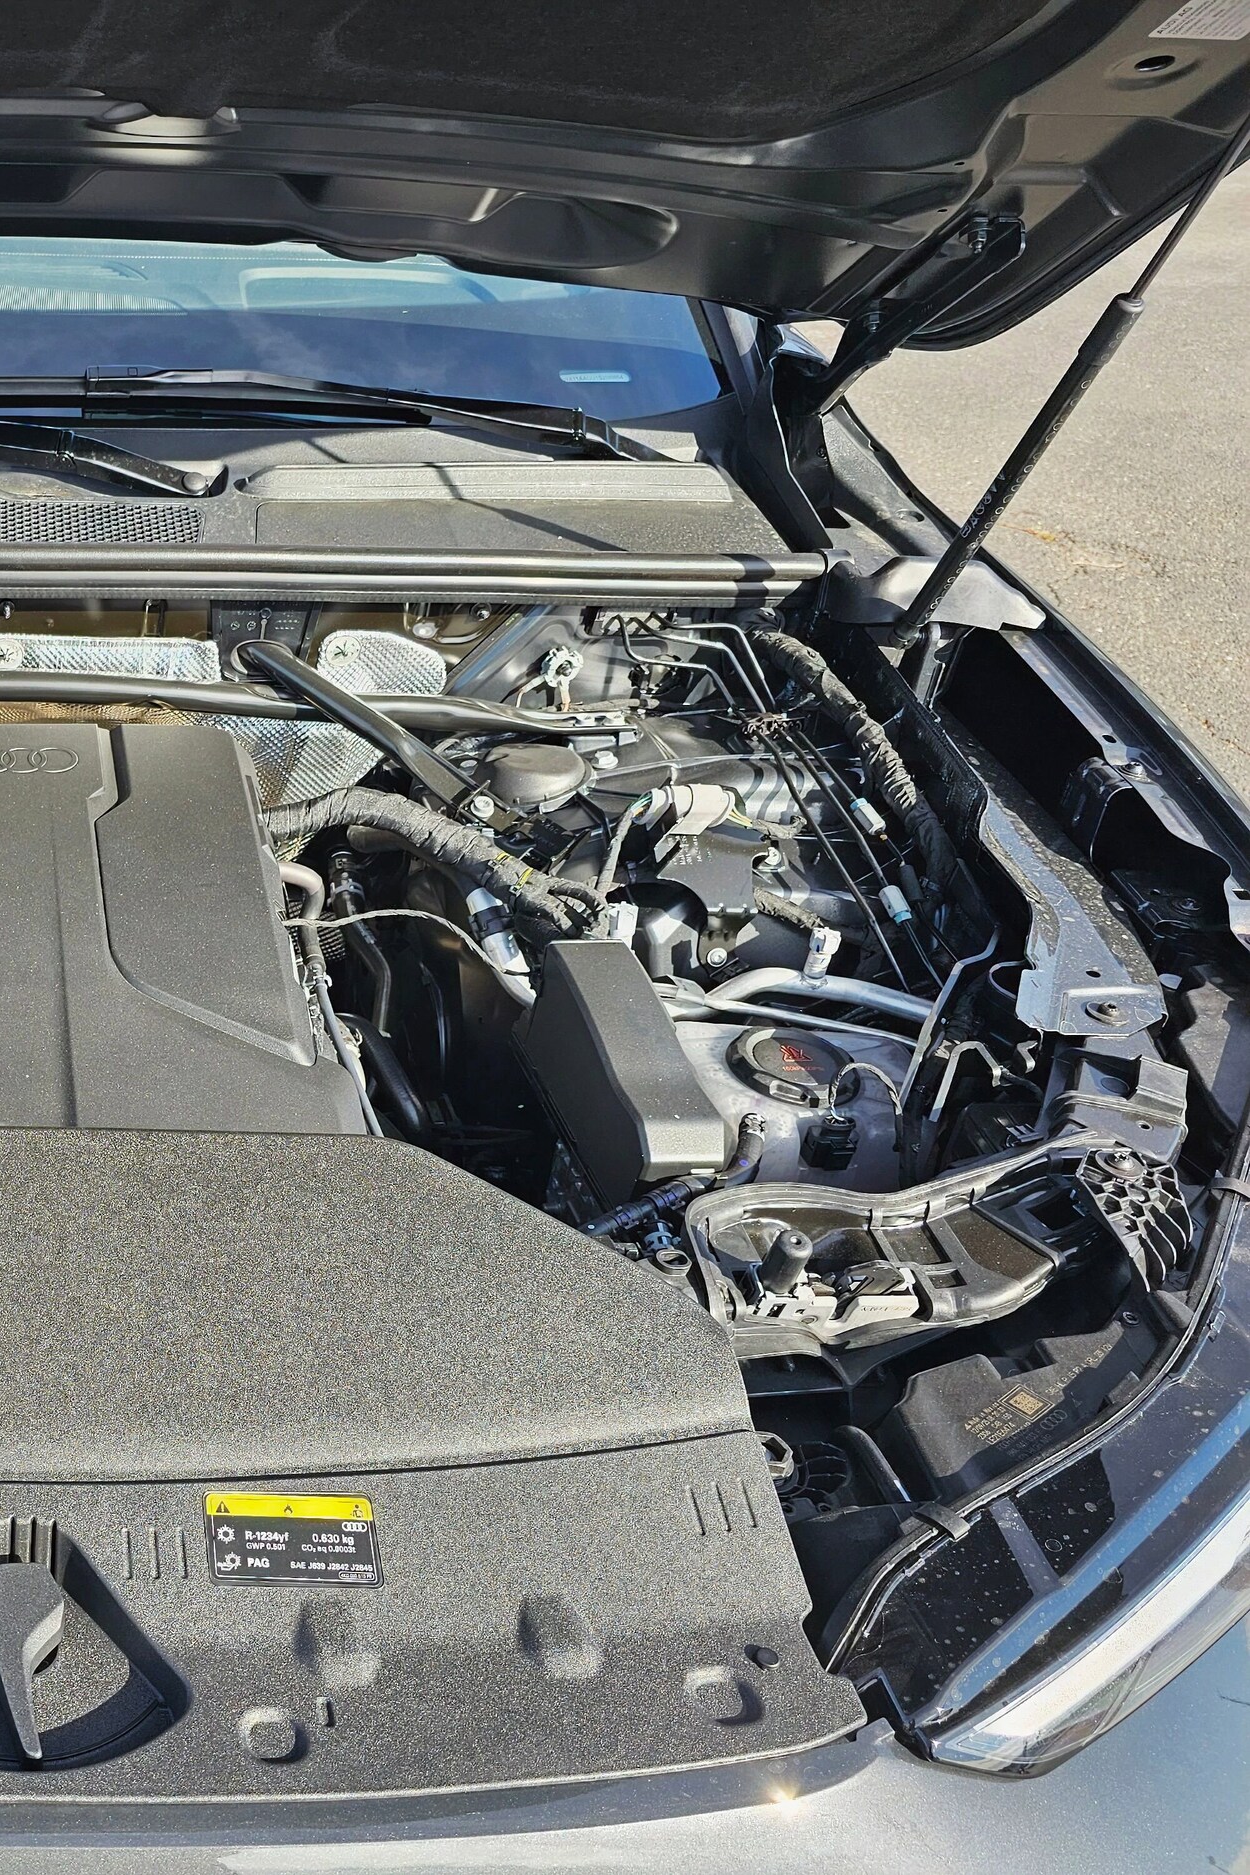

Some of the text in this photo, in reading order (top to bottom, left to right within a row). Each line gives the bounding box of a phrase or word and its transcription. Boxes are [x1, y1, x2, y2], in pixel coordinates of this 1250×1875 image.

[244, 1530, 290, 1542] R-1234yf
[312, 1533, 355, 1545] 0.630 kg
[266, 1543, 286, 1551] 0.501
[317, 1546, 328, 1554] eq
[247, 1557, 270, 1568] PAG
[290, 1561, 373, 1571] SAE J639 J2842 J2845
